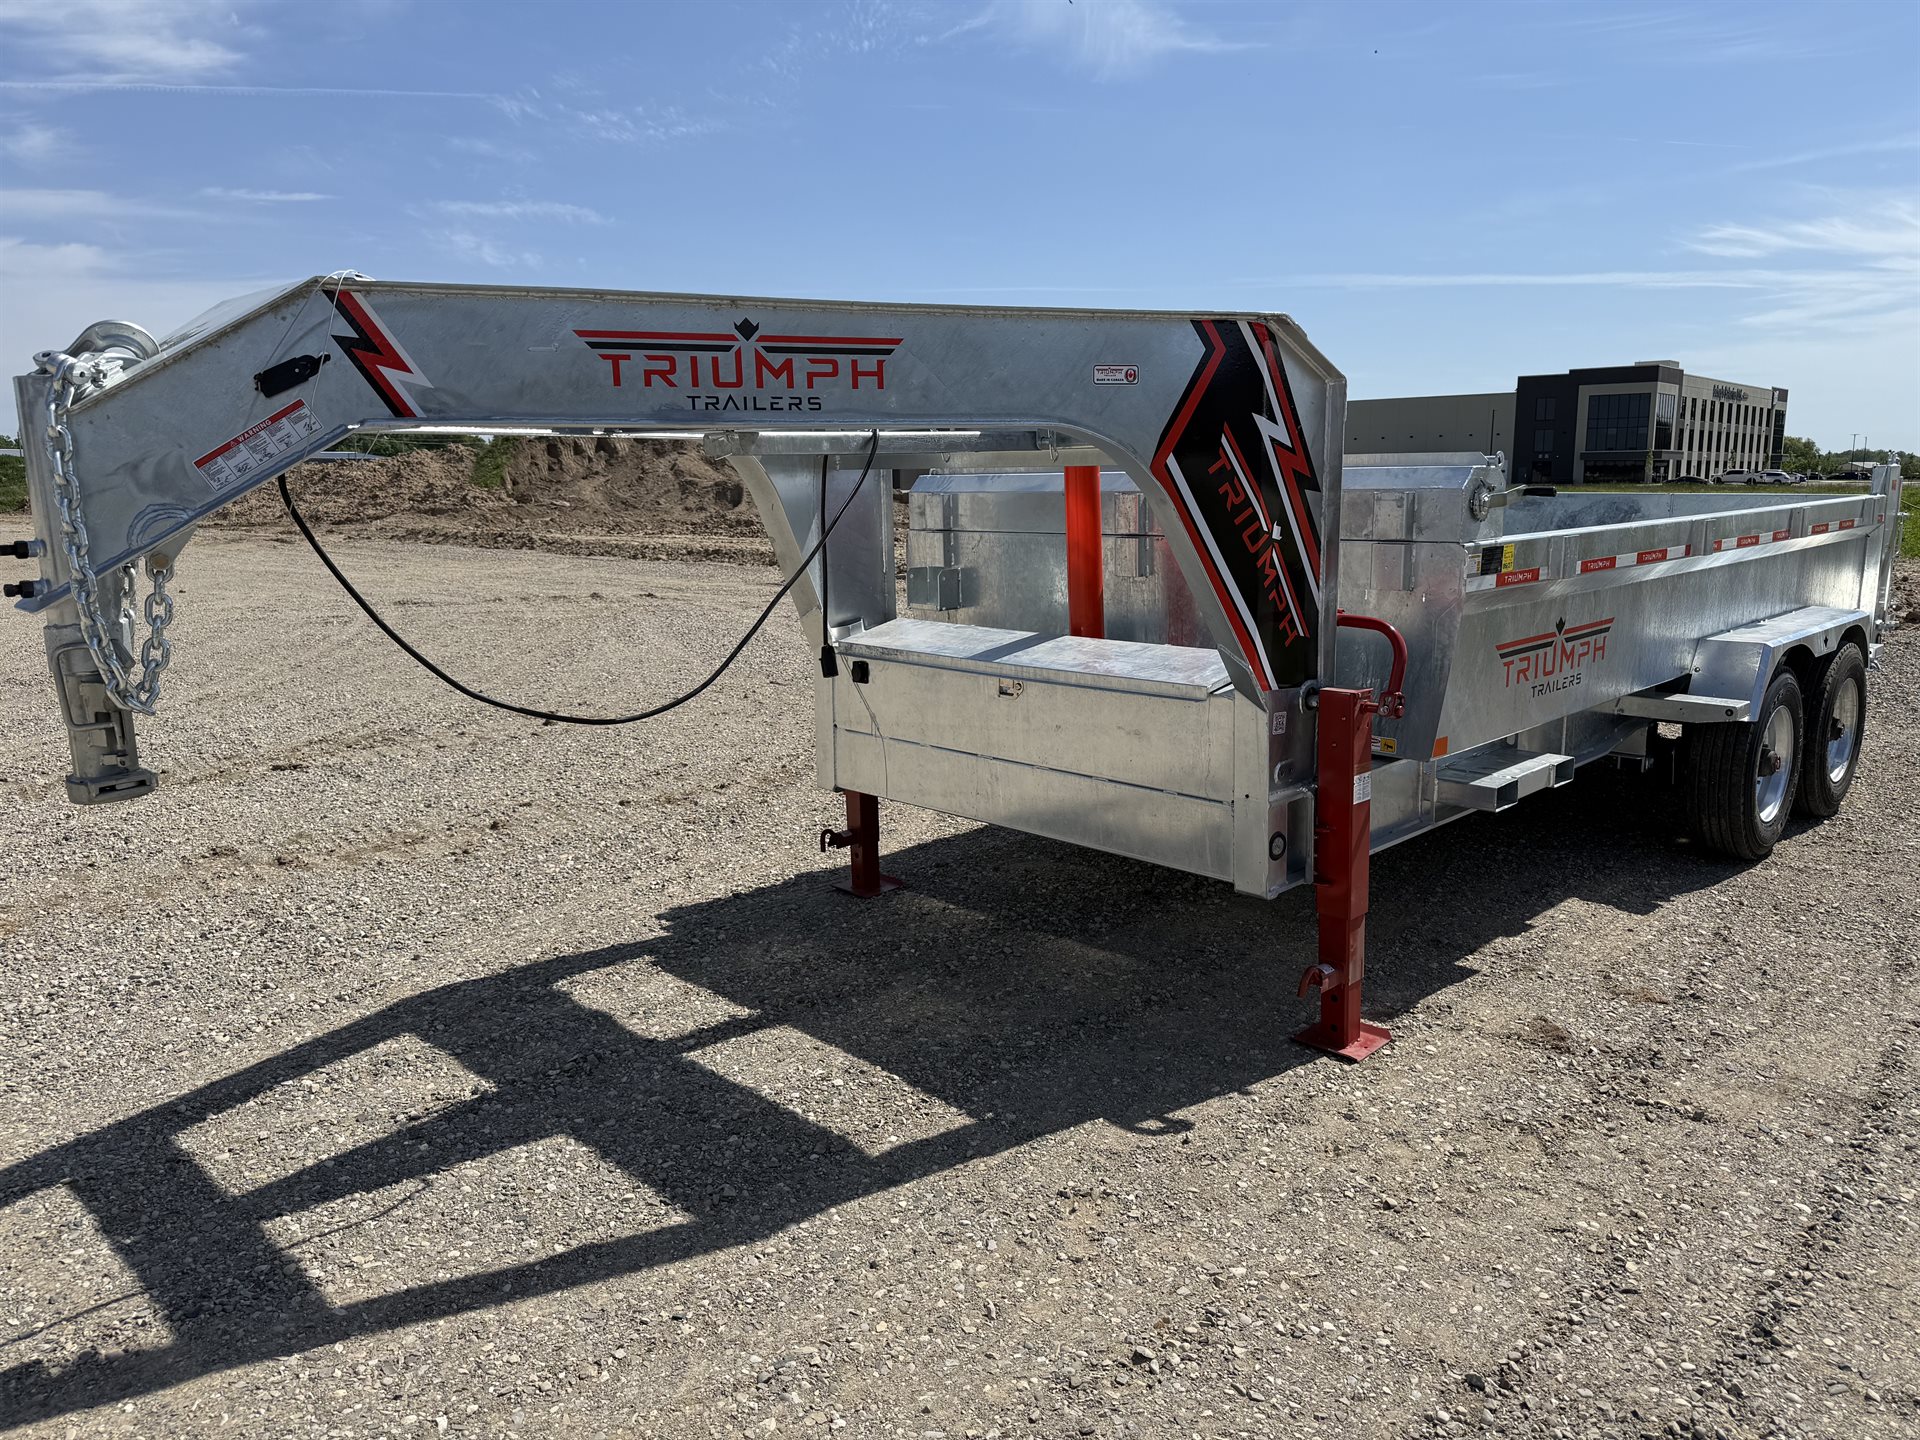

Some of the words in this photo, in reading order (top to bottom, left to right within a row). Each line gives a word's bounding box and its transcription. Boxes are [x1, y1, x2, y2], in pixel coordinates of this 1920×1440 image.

[597, 346, 886, 390] TRIUMPH
[686, 394, 822, 412] TRAILERS
[237, 419, 272, 443] WARNING
[1207, 446, 1299, 648] TRIUMPH
[1504, 572, 1533, 584] TRIUMPH
[1587, 560, 1611, 571] TRIUMPH
[1503, 636, 1608, 688] TRIUMPH
[1531, 672, 1582, 698] TRAILERS
